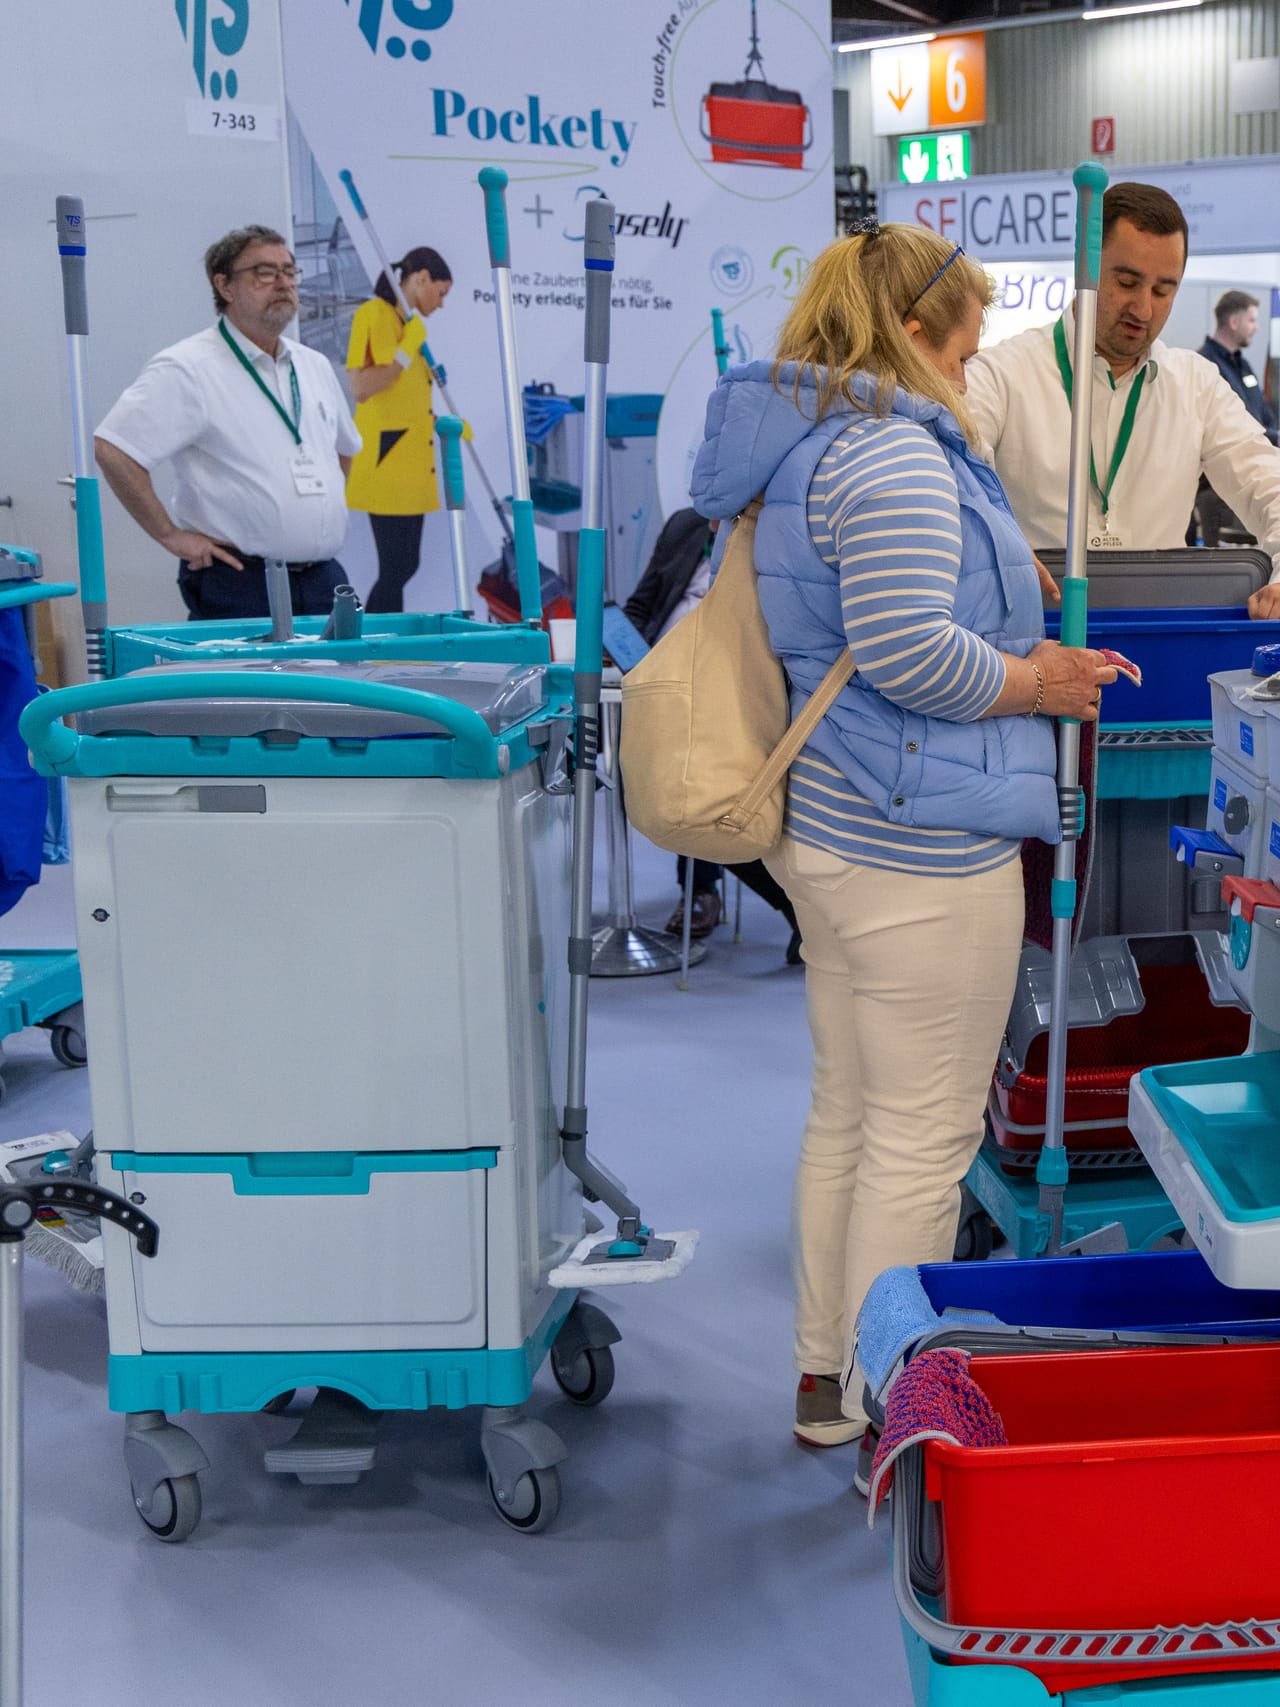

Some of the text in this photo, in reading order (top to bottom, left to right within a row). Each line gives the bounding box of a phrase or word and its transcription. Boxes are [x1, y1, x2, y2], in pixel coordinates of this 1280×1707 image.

[652, 14, 680, 108] Touch-free
[946, 49, 967, 113] 6
[211, 112, 256, 131] 7-343
[429, 88, 637, 167] Pockety
[535, 292, 585, 309] erledig
[629, 294, 649, 308] für
[653, 296, 673, 310] Sie
